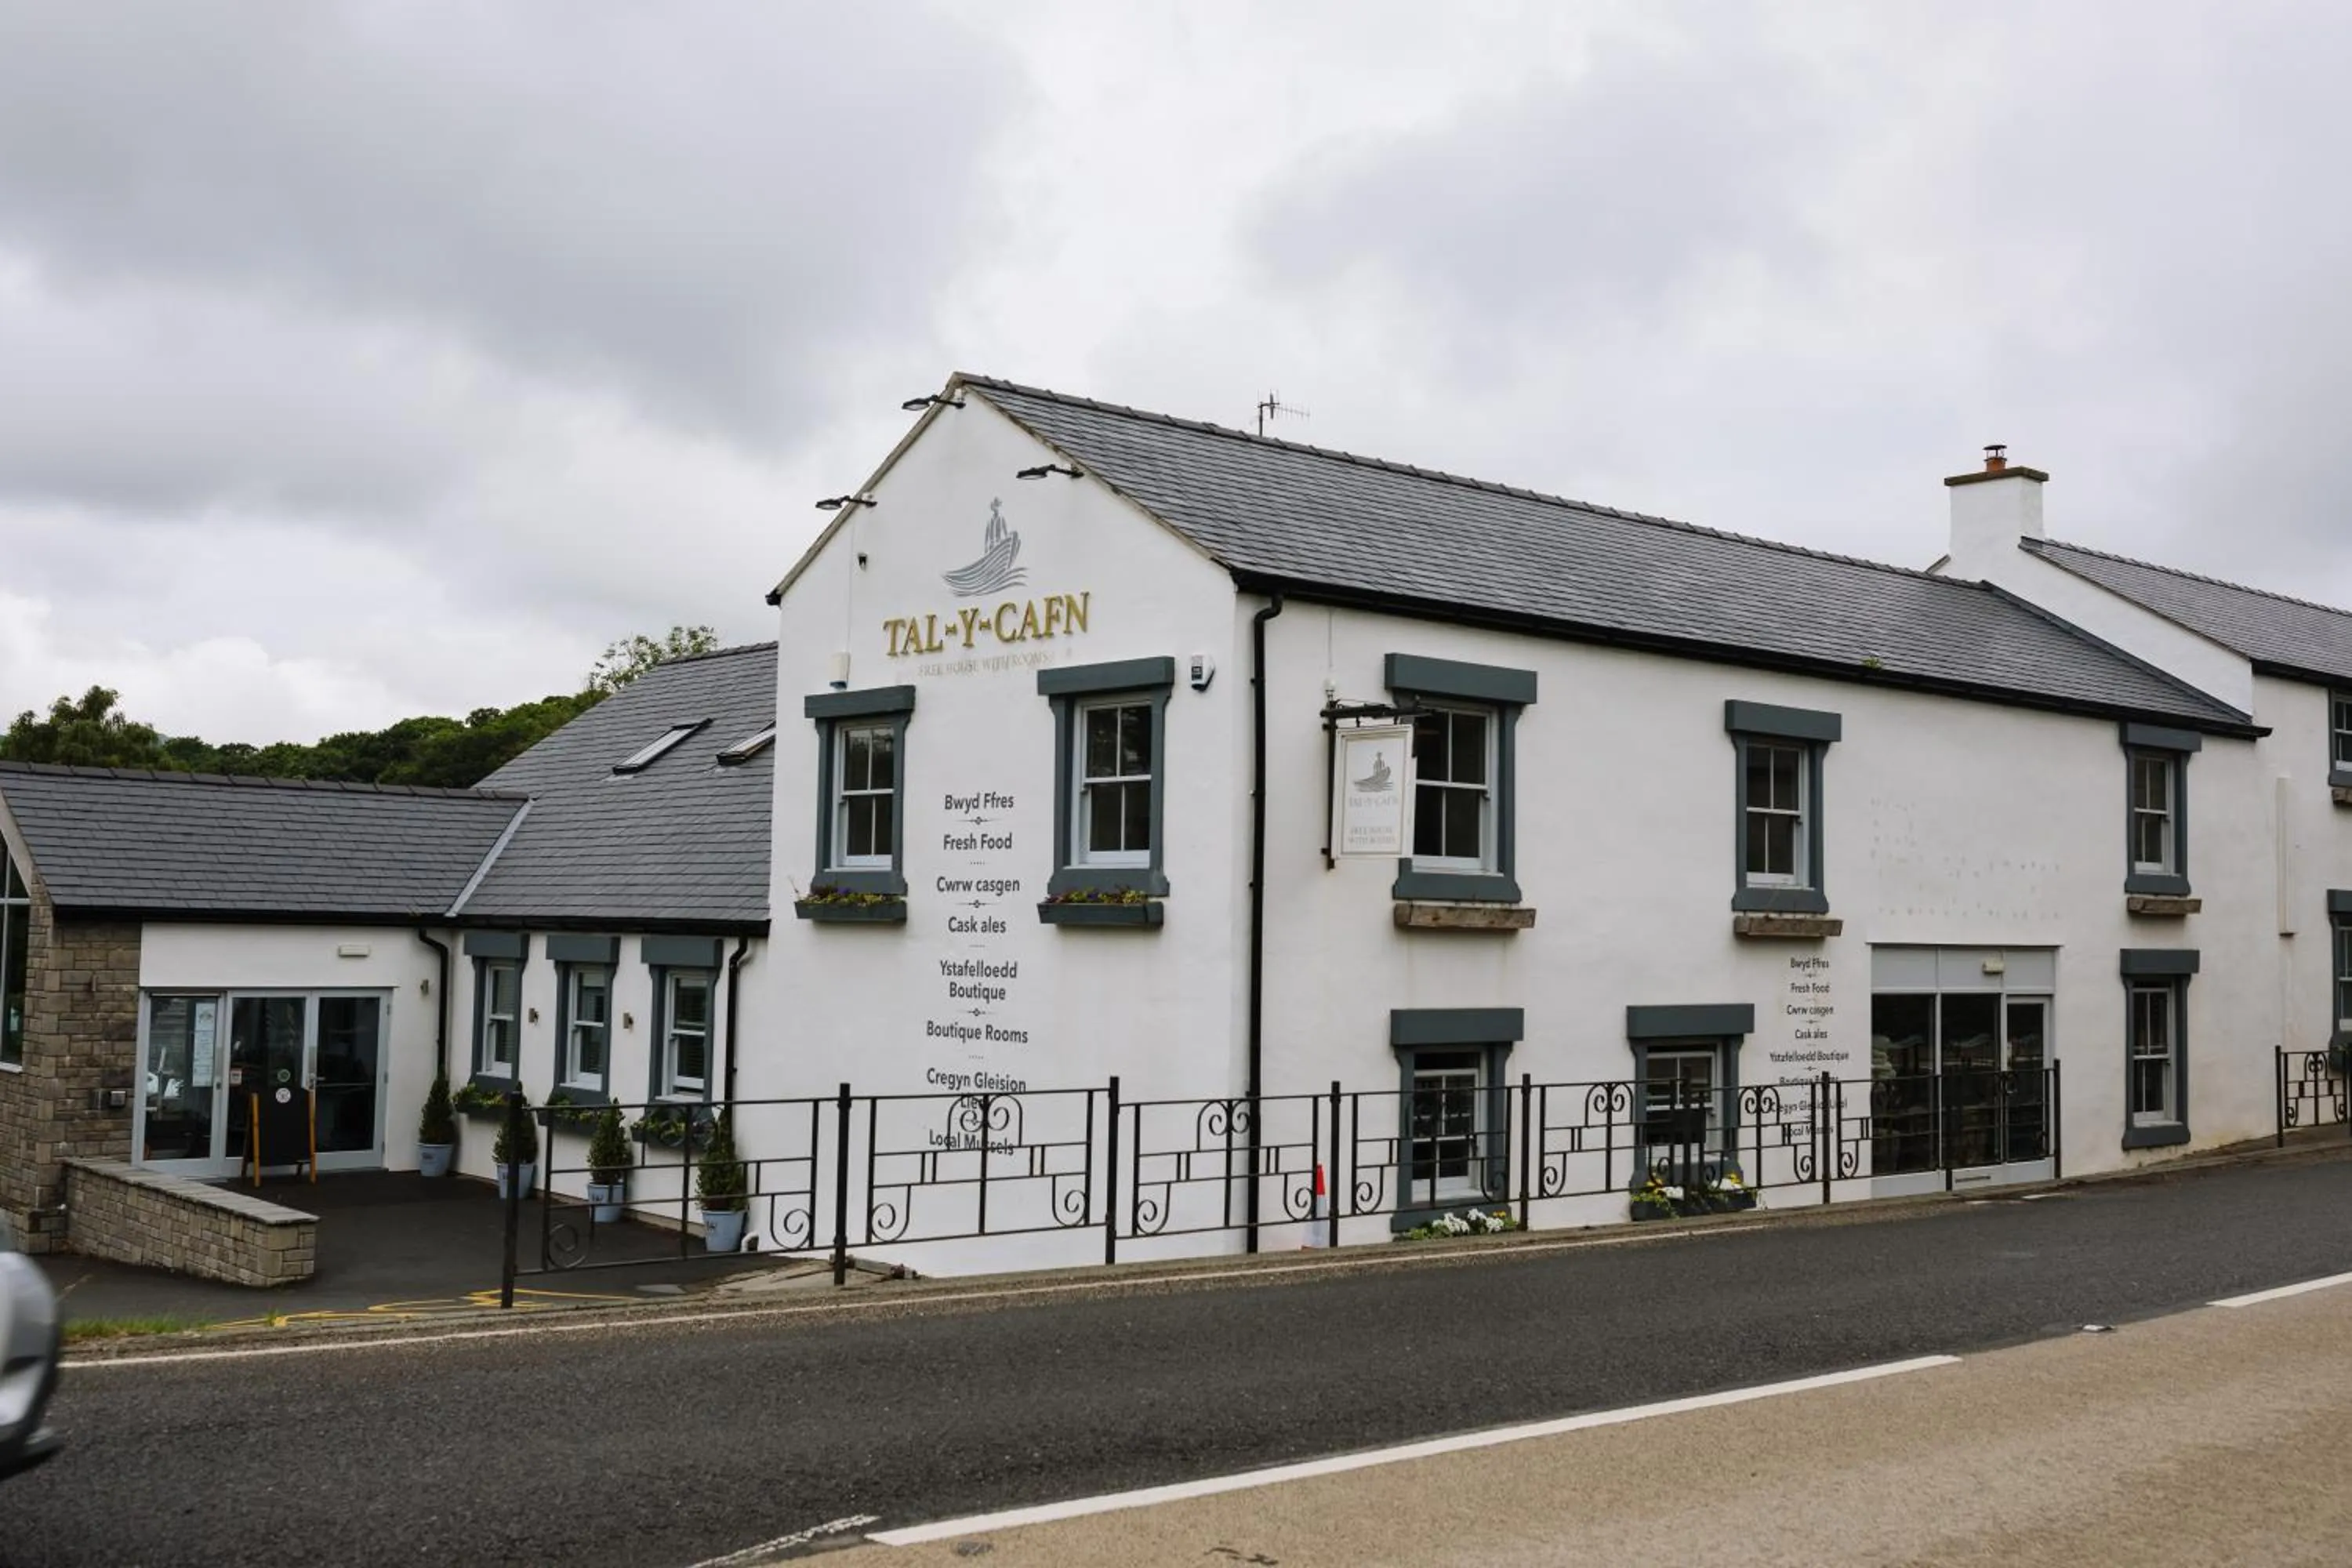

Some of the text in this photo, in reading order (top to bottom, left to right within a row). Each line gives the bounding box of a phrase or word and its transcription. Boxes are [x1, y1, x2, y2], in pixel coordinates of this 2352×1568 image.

[883, 591, 1090, 657] TAL-Y-CAFN
[944, 791, 1014, 814] Bwyd Ffres
[943, 832, 1013, 850] Fresh Food
[937, 876, 1020, 896] Cwrw casgen
[948, 916, 1007, 933] Cask ales
[940, 959, 1018, 978] Ystafelloedd
[949, 982, 1006, 1004] Boutique
[927, 1020, 1029, 1044] Boutique Rooms
[927, 1067, 1026, 1094] Cregyn Gleision
[929, 1128, 960, 1149] Local
